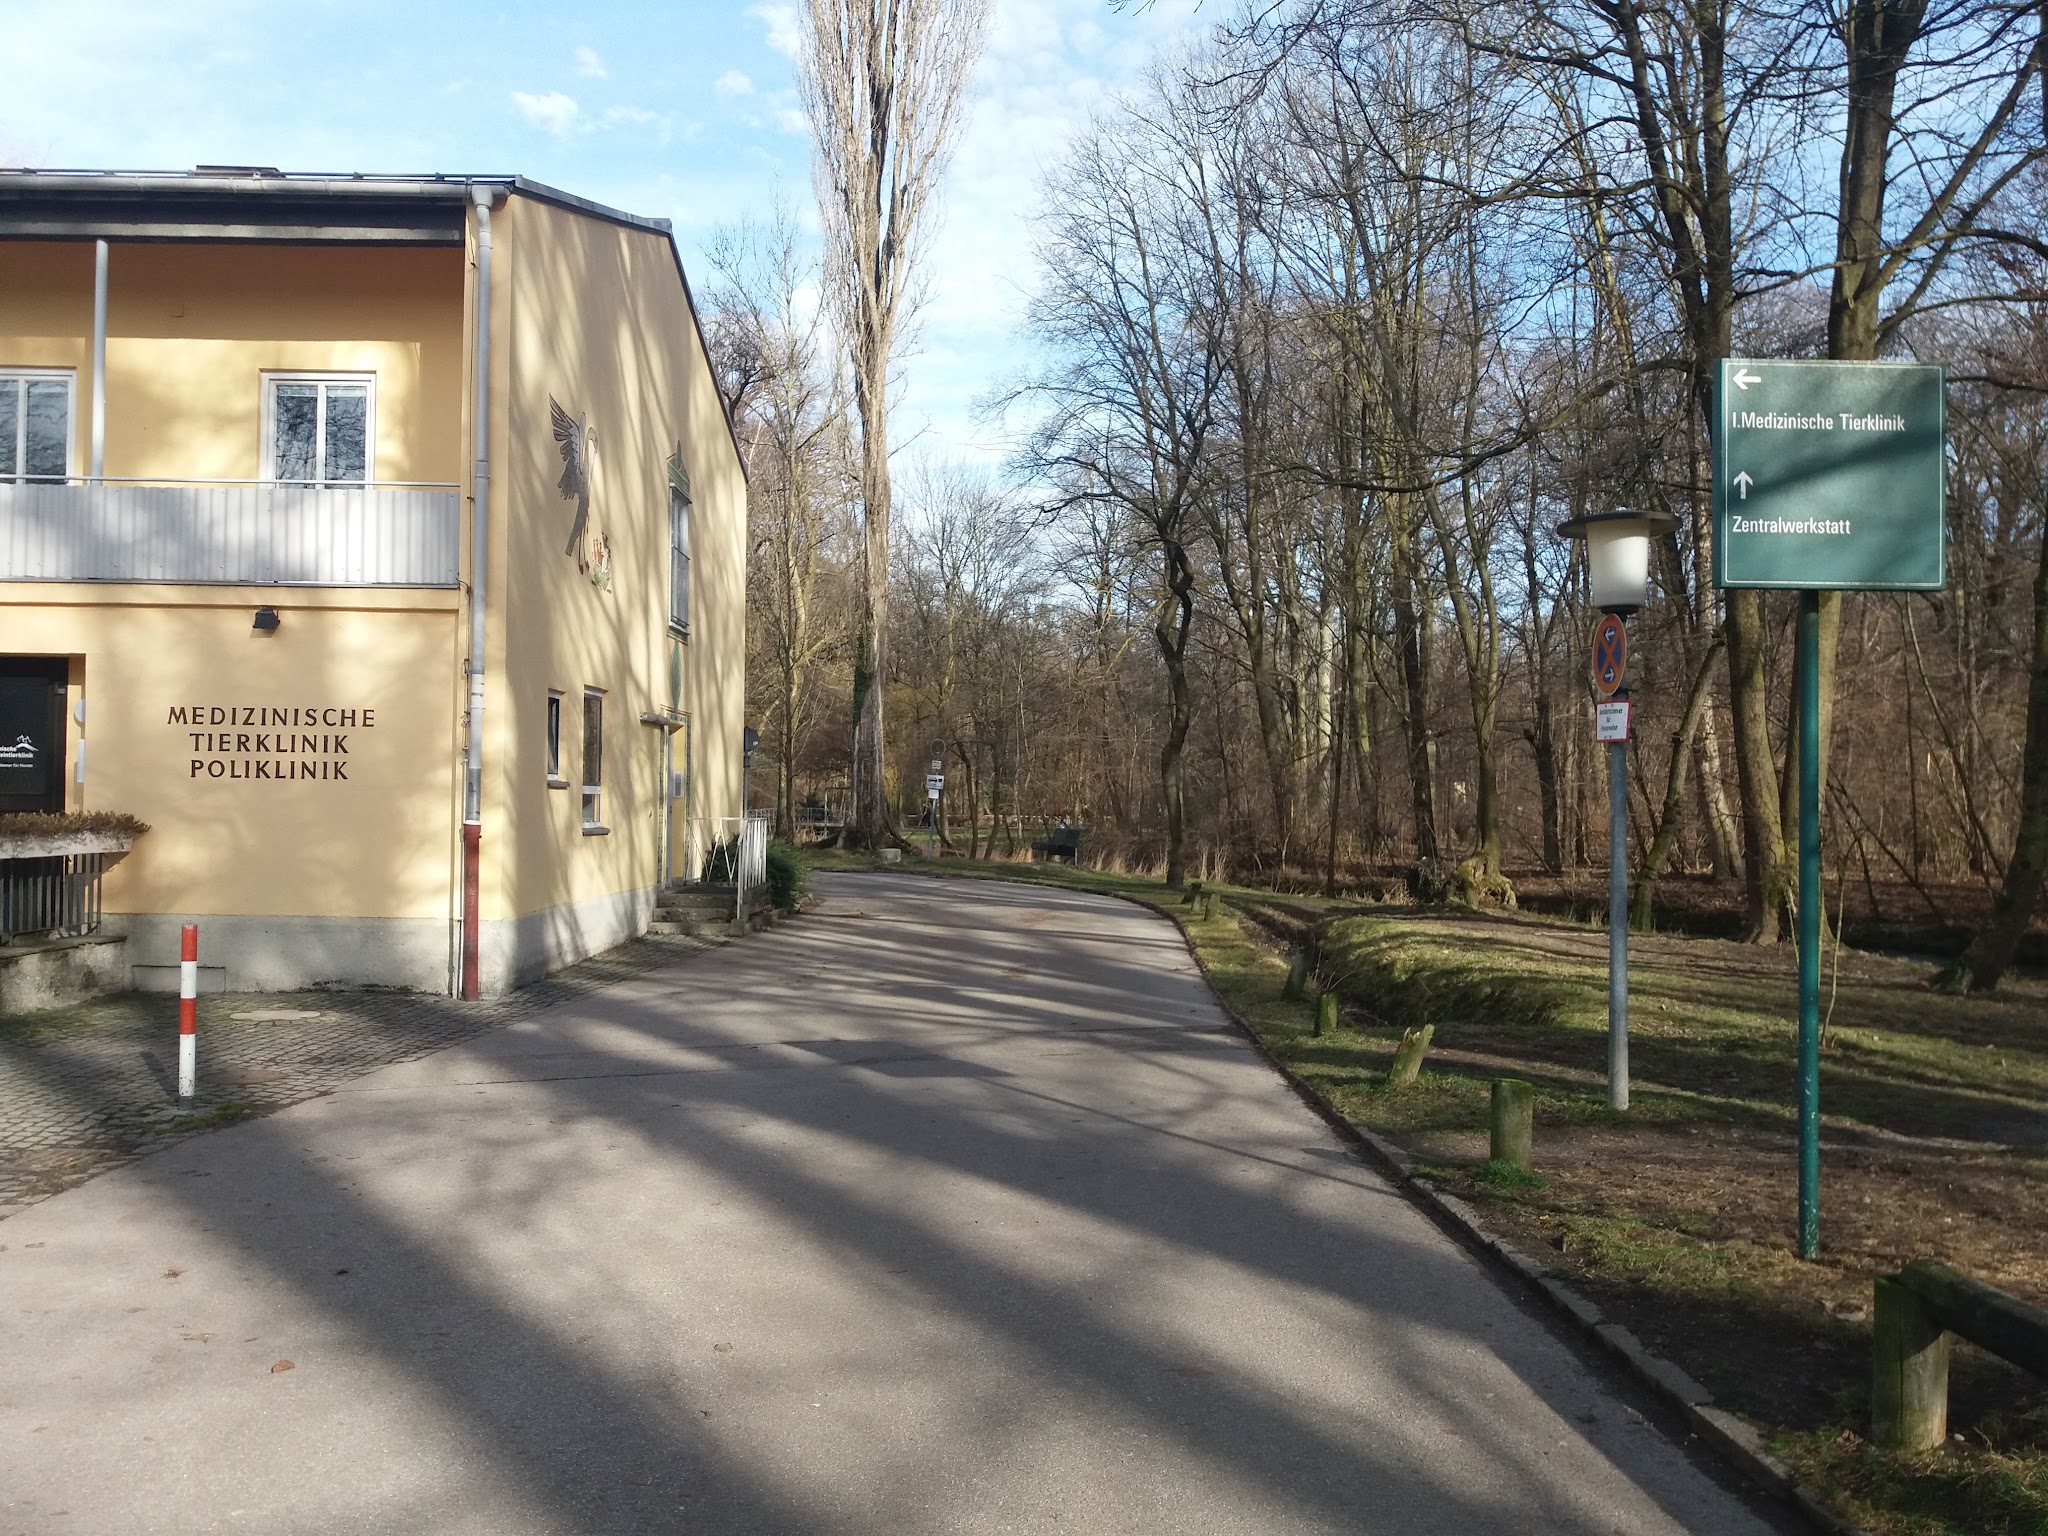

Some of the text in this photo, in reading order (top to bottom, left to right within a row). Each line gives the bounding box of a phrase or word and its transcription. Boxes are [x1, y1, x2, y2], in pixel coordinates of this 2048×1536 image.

[1839, 412, 1906, 432] Tierklinik
[1732, 515, 1851, 535] Zentralwerkstatt
[167, 706, 375, 728] MEDIZINISCHE
[189, 733, 349, 754] TIERKLINIK
[190, 759, 349, 780] POLIKLINIK
